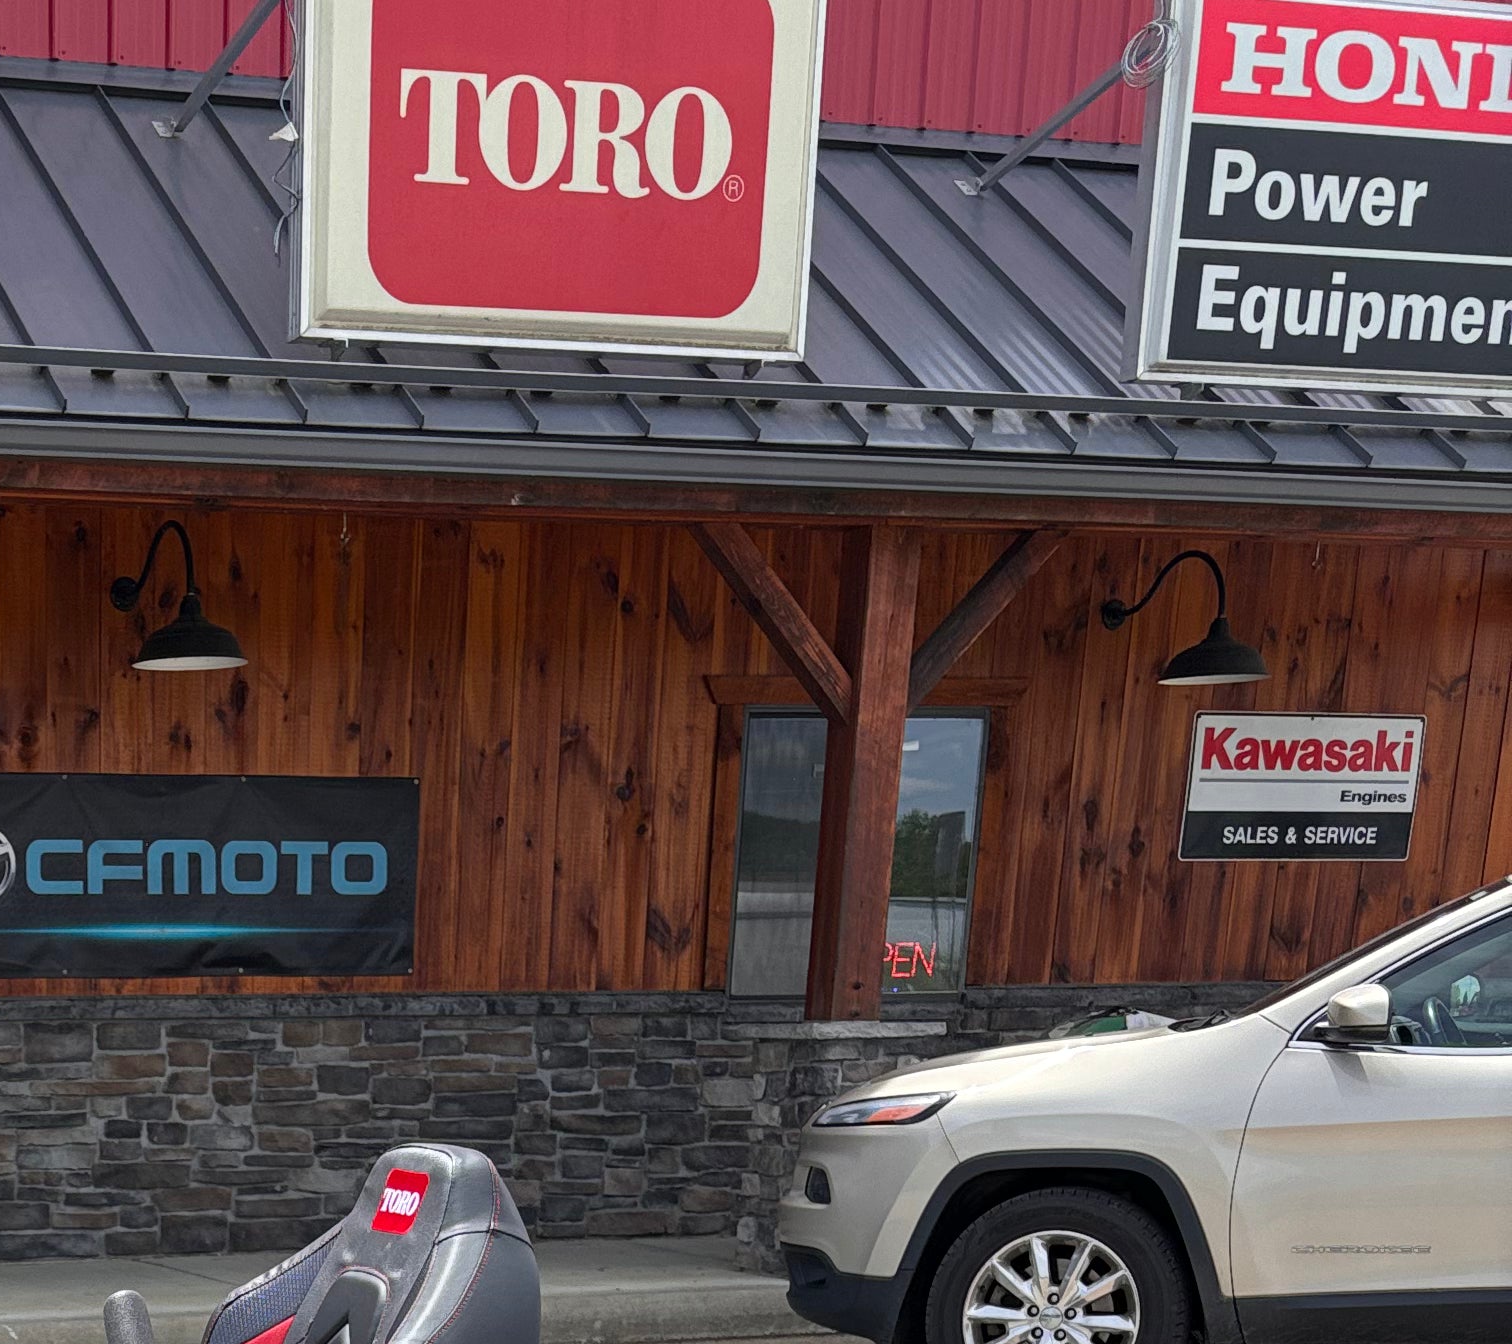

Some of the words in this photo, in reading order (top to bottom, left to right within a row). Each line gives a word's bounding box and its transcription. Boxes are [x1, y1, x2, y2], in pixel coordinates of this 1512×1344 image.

[400, 68, 733, 201] TORO
[1208, 148, 1429, 227] Power
[1201, 727, 1414, 773] Kawasaki
[1340, 790, 1407, 806] Engines
[1222, 826, 1279, 845] SALES
[1285, 827, 1297, 845] &
[1304, 827, 1378, 845] SERVICE
[25, 839, 388, 895] CFMOTO
[379, 1187, 420, 1216] TORO
